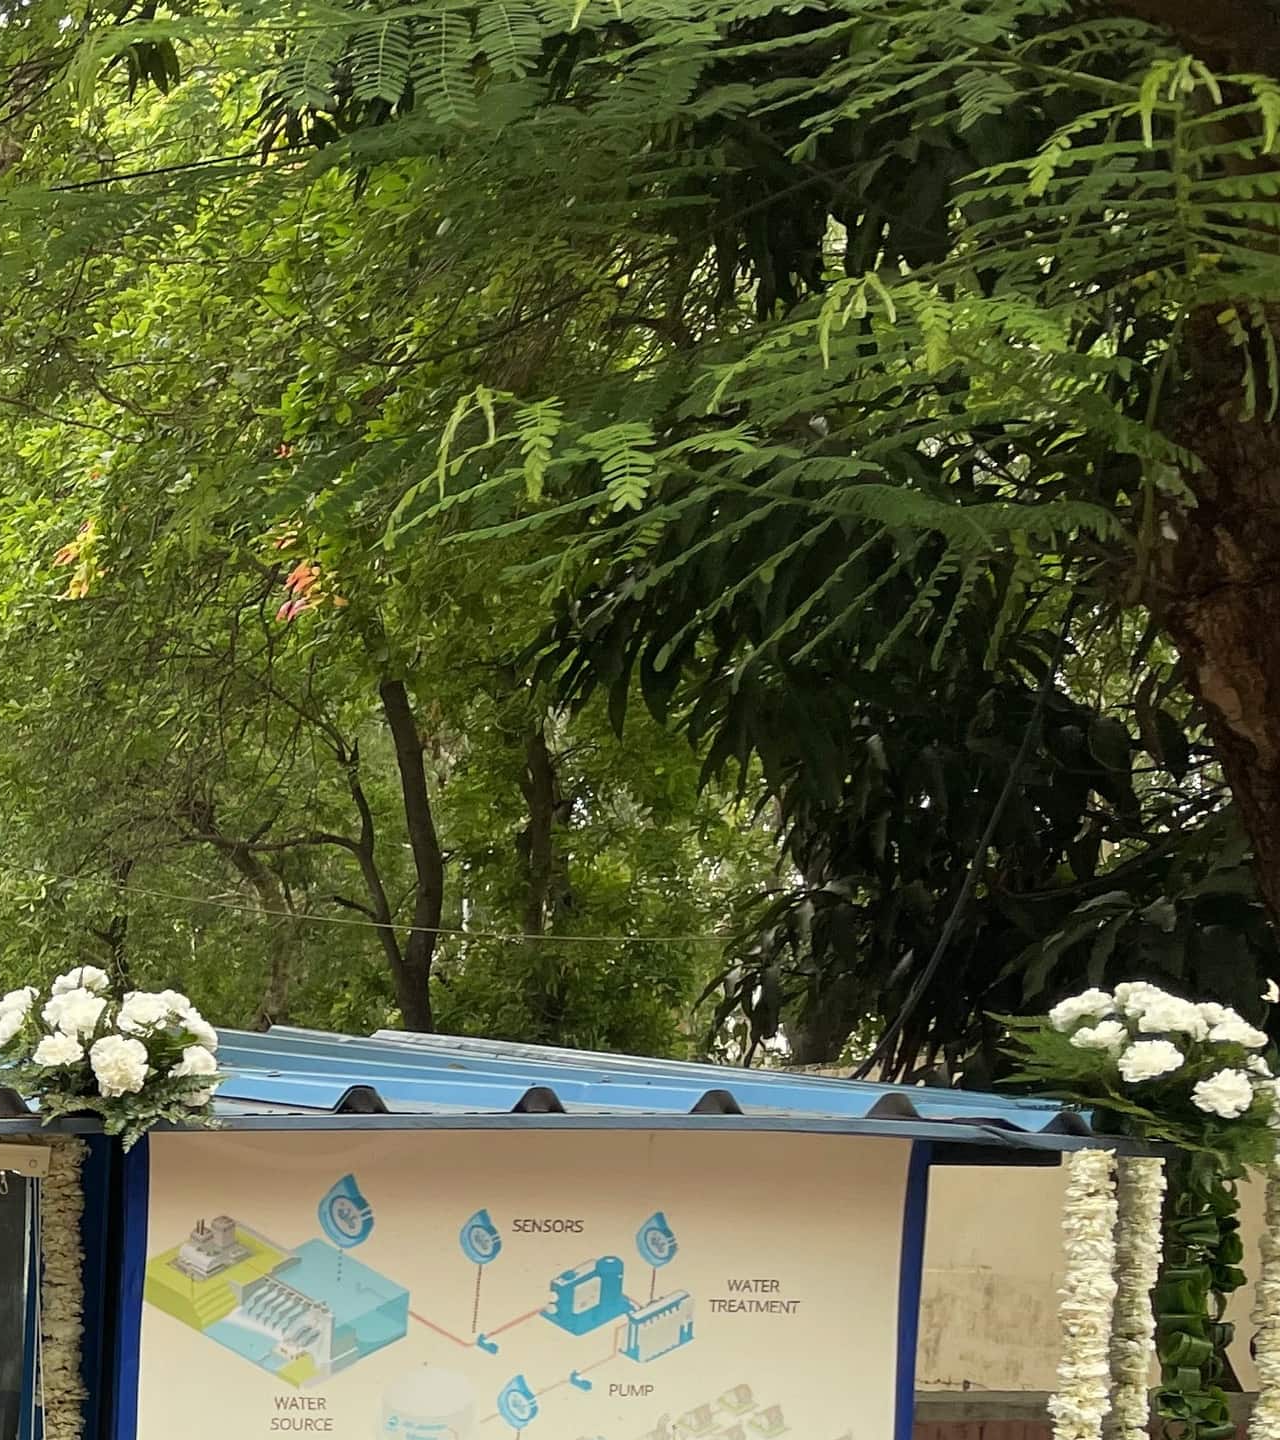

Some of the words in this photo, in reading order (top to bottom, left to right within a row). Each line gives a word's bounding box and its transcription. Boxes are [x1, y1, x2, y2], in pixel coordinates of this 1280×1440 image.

[512, 1219, 584, 1233] SENSORS
[728, 1280, 779, 1292] WATER
[709, 1299, 800, 1313] TREATMENT
[609, 1384, 654, 1396] PUMP
[275, 1397, 326, 1410] WATER
[271, 1418, 333, 1431] SOURCE
